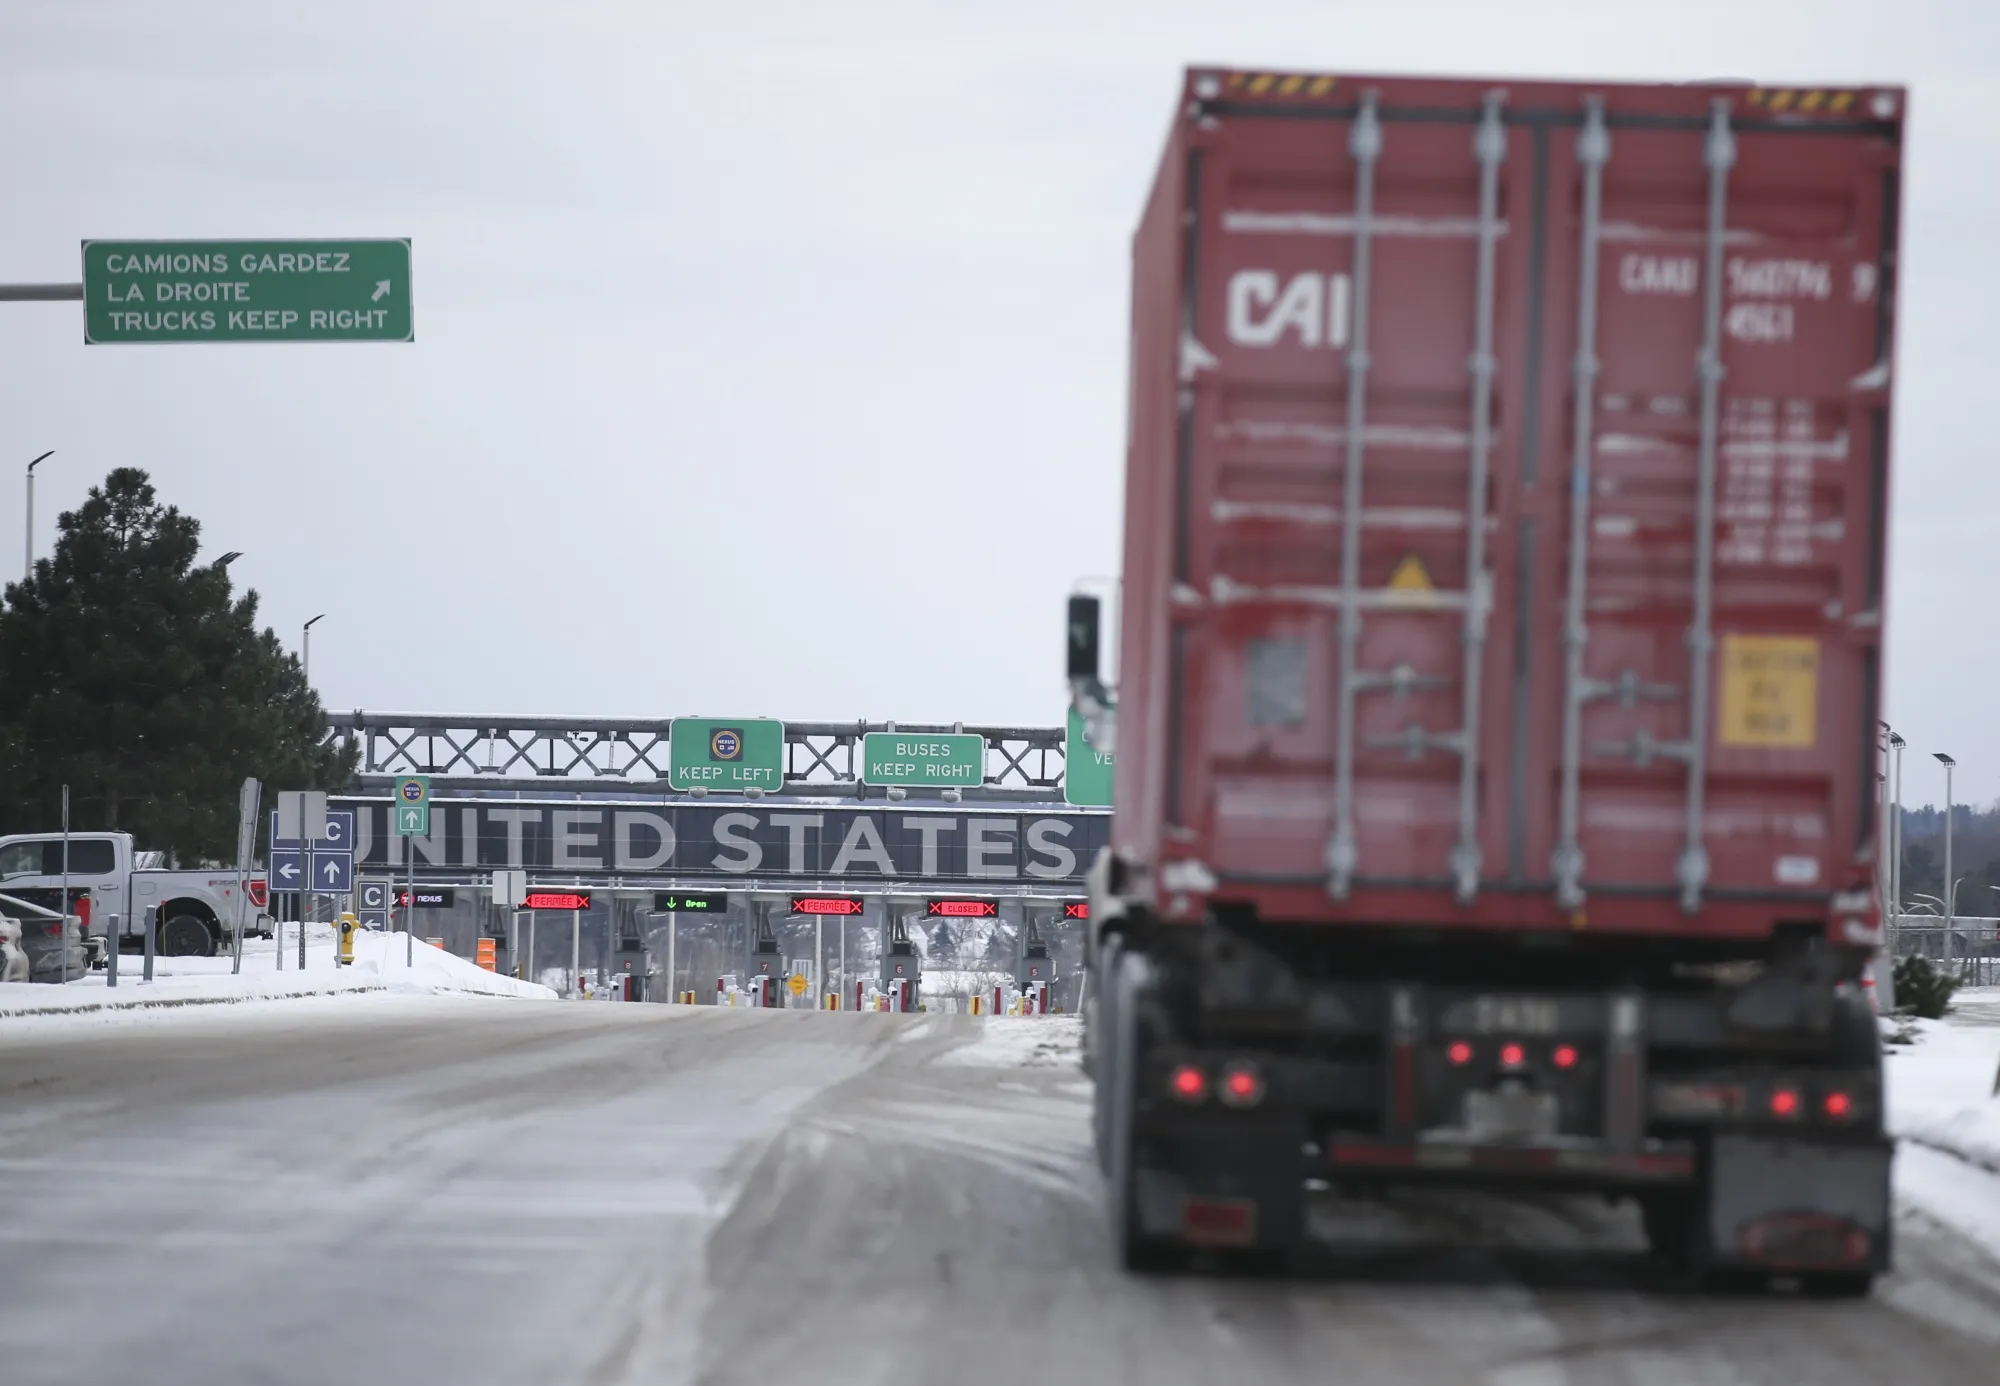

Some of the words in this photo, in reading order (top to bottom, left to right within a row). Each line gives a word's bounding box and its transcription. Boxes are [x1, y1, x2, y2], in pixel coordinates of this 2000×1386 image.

[106, 253, 229, 275] CAMIONS
[240, 252, 351, 273] GARDEZ
[107, 282, 145, 303] LA
[156, 281, 251, 302] DROITE
[1226, 270, 1351, 348] CAI
[108, 311, 217, 332] TRUCKS
[228, 310, 299, 331] KEEP
[310, 309, 388, 330] RIGHT
[896, 742, 951, 757] BUSES
[679, 766, 723, 780] KEEP
[732, 767, 773, 781] LEFT
[872, 762, 916, 776] KEEP
[925, 763, 973, 777] RIGHT
[326, 821, 341, 841] C
[711, 812, 1077, 880] STATES
[364, 886, 381, 906] C
[534, 895, 573, 906] FERMÉE
[685, 899, 707, 908] Open
[807, 900, 846, 911] FERMÉE
[947, 905, 978, 913] CLOSED
